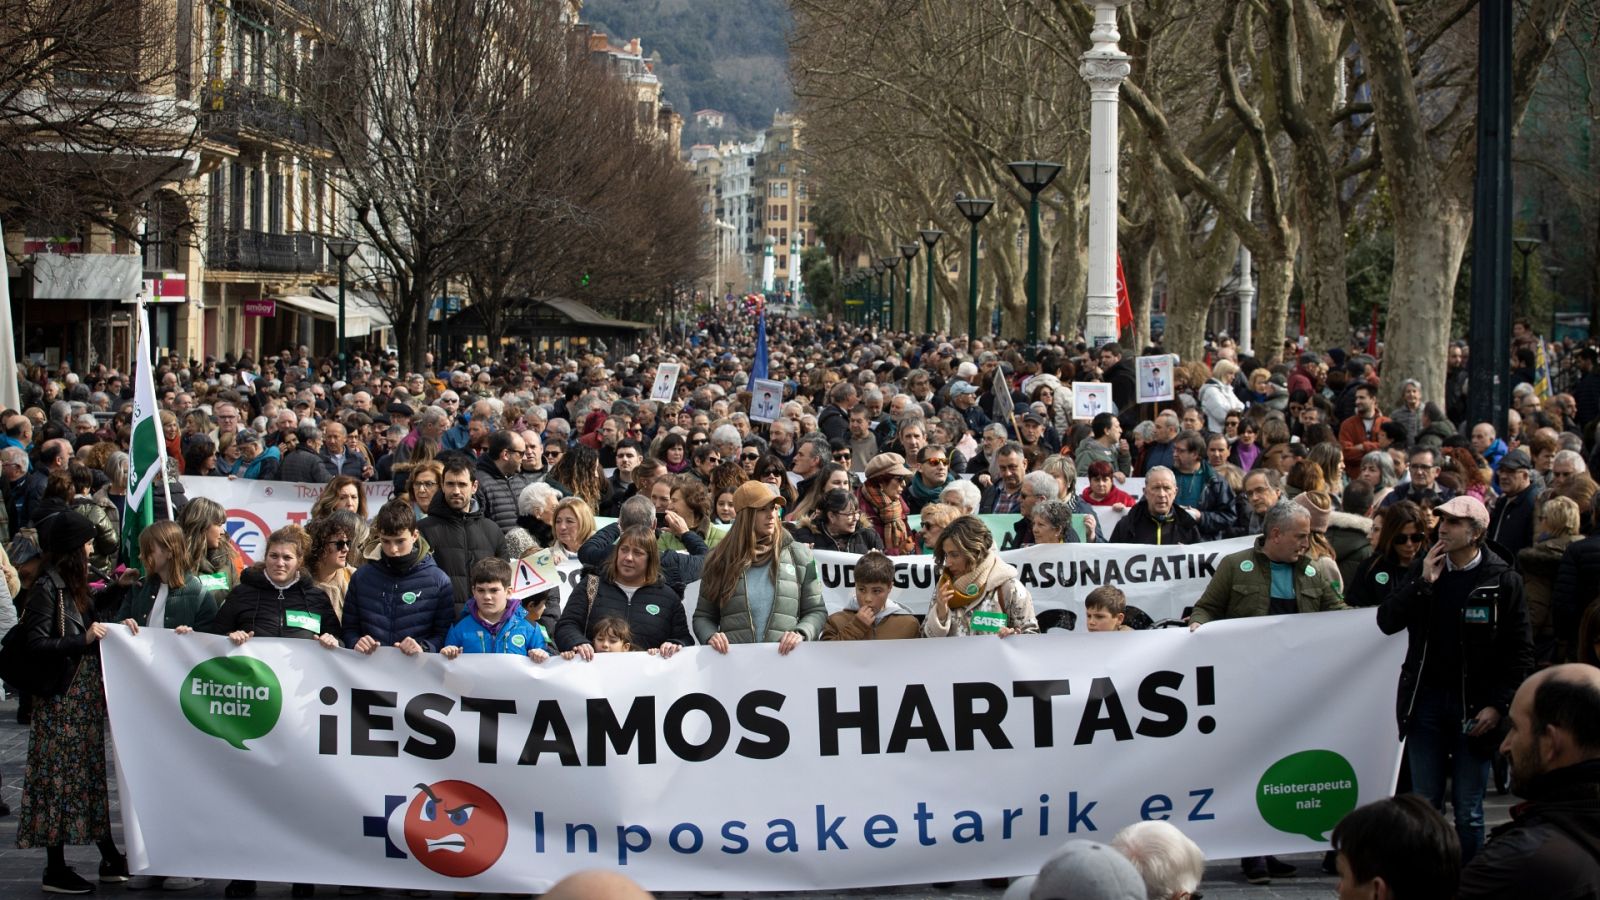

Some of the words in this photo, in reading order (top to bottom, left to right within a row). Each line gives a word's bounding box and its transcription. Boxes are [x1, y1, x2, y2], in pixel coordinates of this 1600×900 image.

[1005, 552, 1219, 589] ASUNAGATIK
[973, 615, 1007, 628] SATSE
[192, 678, 270, 700] Erizaina
[210, 700, 251, 717] naiz
[318, 686, 791, 767] ¡ESTAMOS
[817, 666, 1217, 756] HARTAS!
[1263, 780, 1352, 795] Fisioterapeuta
[1296, 798, 1321, 809] naiz
[534, 791, 1098, 865] Inposaketarik
[1140, 788, 1215, 821] ez
